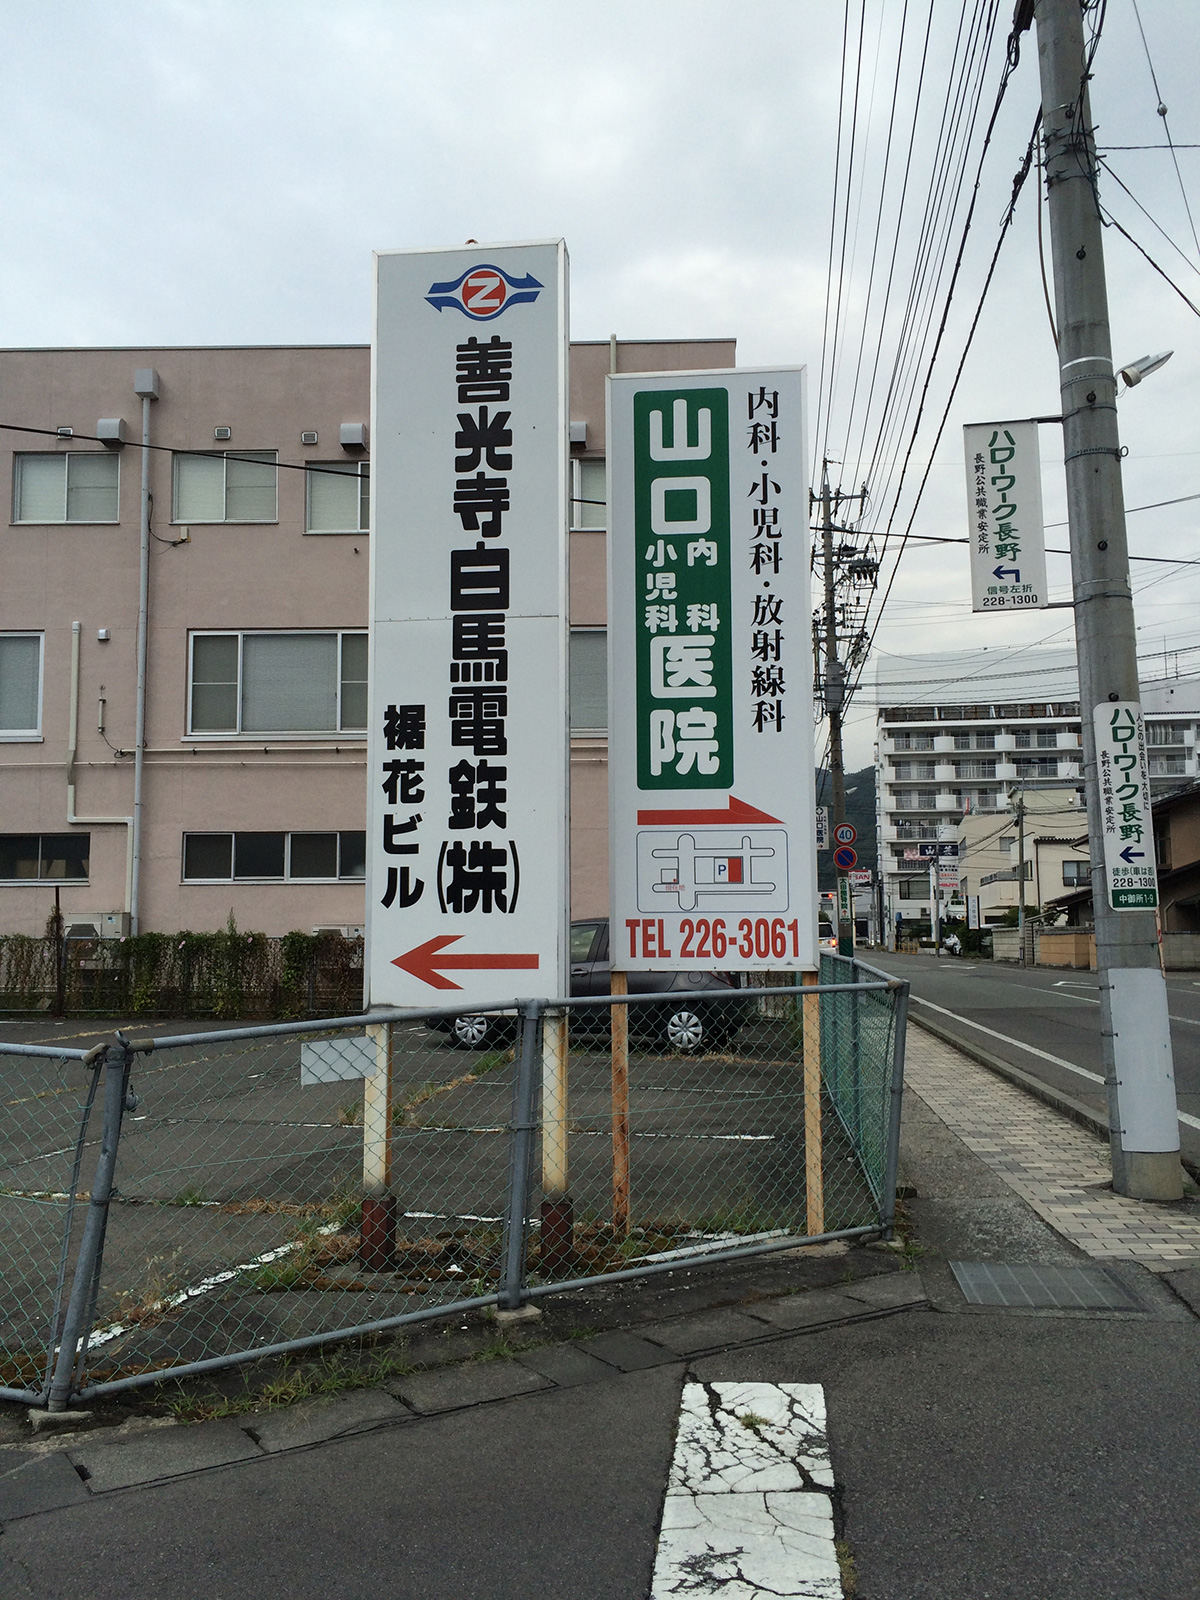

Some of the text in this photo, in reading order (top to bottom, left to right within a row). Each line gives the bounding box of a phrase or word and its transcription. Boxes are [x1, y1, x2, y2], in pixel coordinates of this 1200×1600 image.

[974, 453, 990, 554] 長野公共職業安定所
[988, 430, 1022, 562] ハローワーク長野
[983, 595, 1038, 606] 228-1300
[987, 584, 1033, 595] 信号左折
[1100, 750, 1116, 834] 長野公共職業安定所
[1109, 708, 1145, 844] ハローワーク長野
[380, 704, 427, 910] 裾花ビル
[839, 830, 852, 839] 40
[718, 865, 727, 875] P
[1113, 877, 1156, 888] 228-1300
[625, 917, 800, 959] TEL 226-3061
